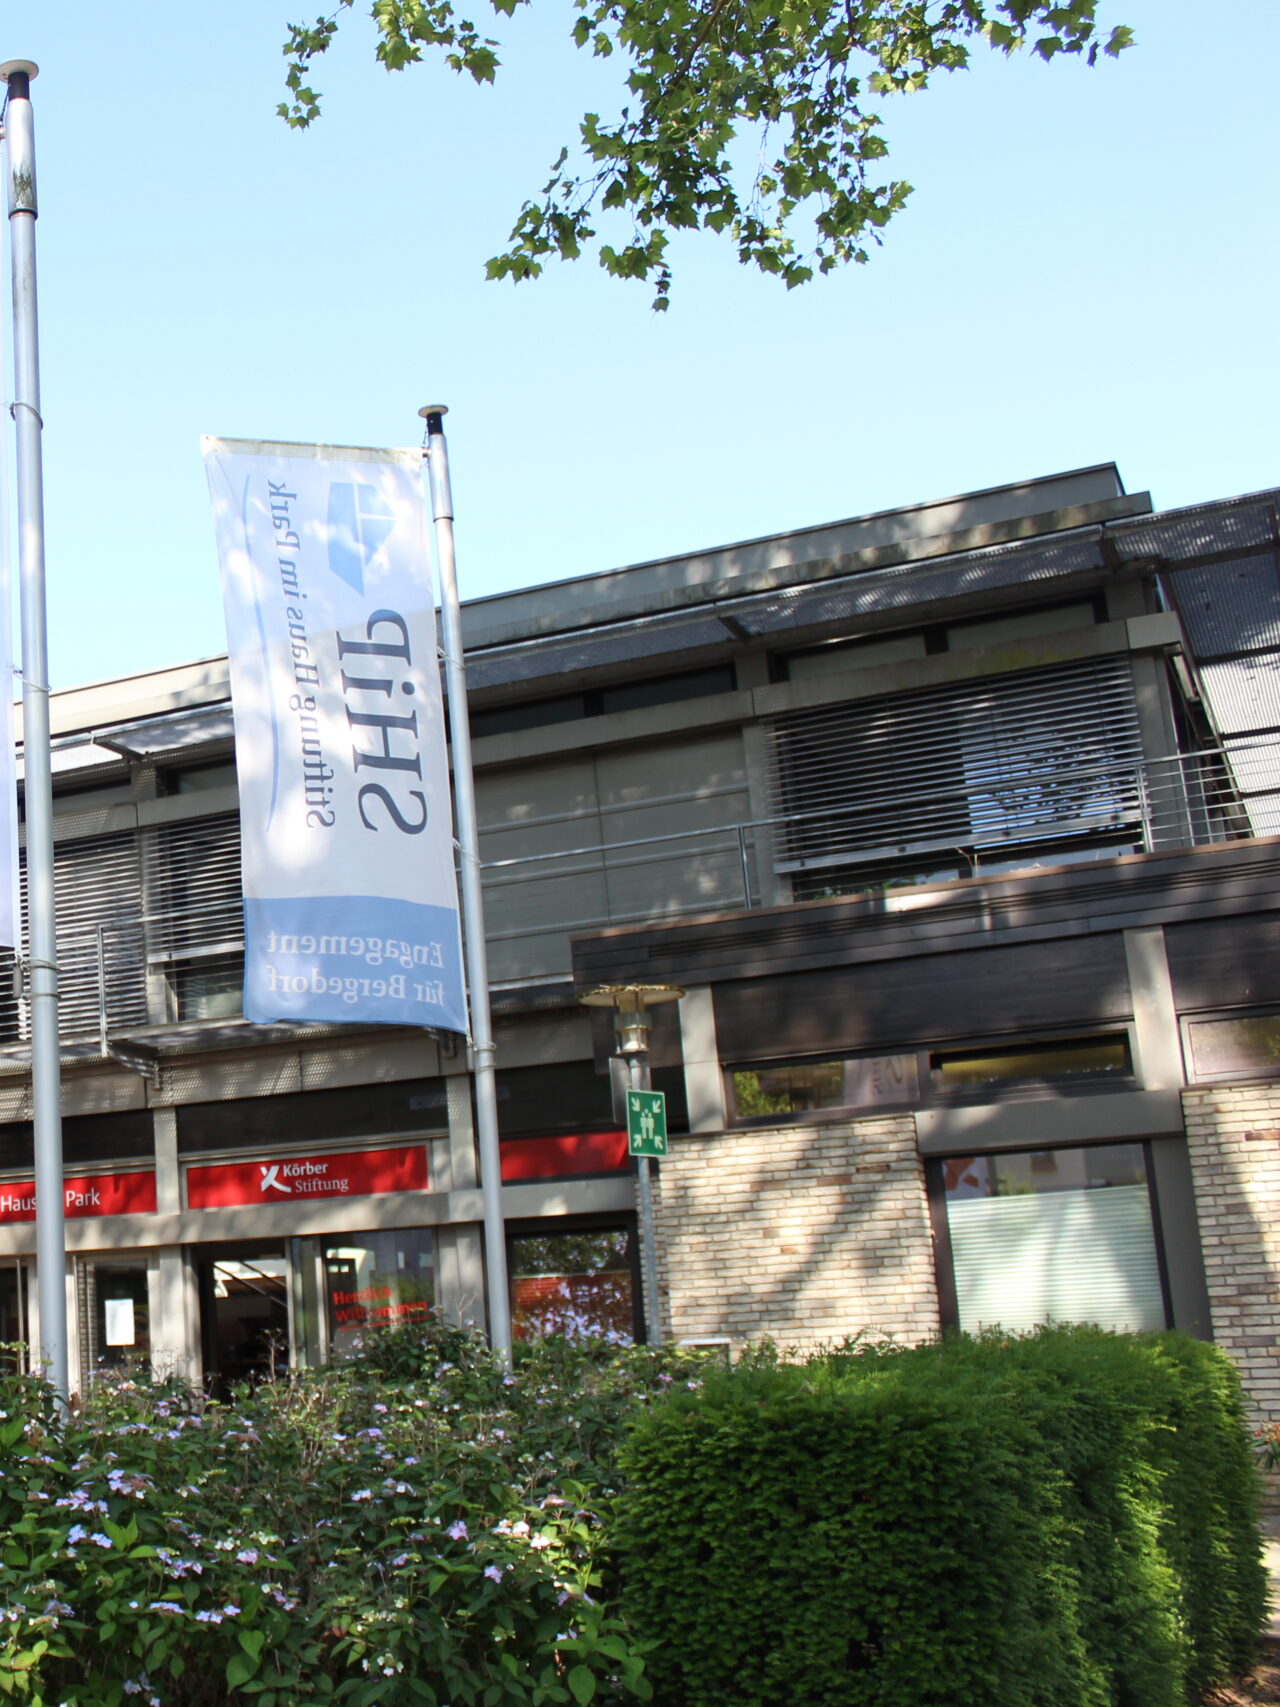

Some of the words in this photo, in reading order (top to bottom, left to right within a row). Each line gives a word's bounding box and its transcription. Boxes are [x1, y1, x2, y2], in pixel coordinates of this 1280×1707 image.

[283, 1162, 328, 1177] Körber
[295, 1178, 349, 1193] Stiftung
[0, 1195, 37, 1212] Haus
[65, 1187, 101, 1207] Park
[332, 1285, 392, 1305] Herzlich
